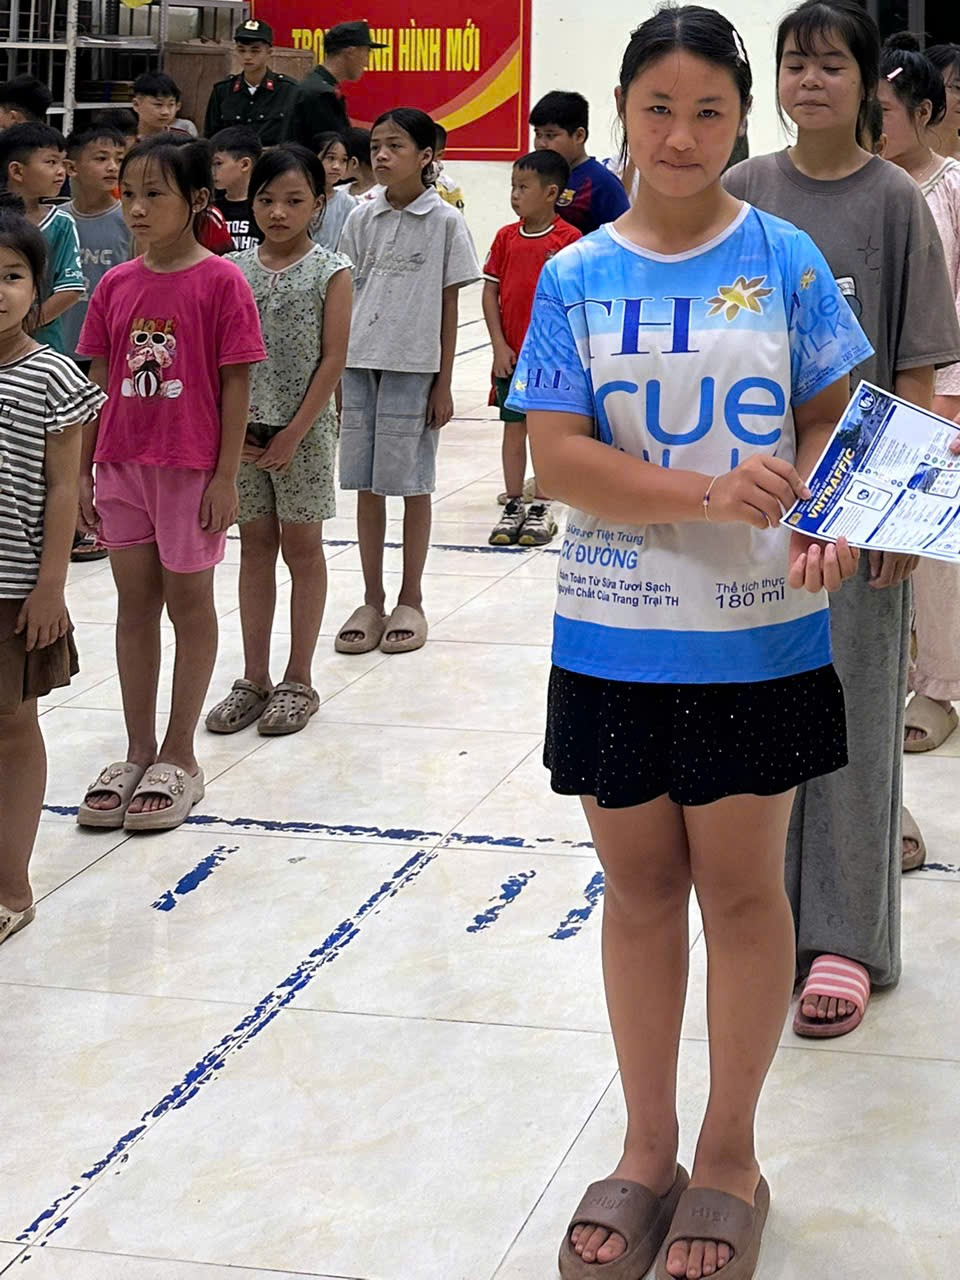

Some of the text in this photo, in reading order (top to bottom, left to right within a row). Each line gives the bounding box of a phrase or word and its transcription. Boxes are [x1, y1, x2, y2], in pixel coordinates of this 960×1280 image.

[291, 27, 327, 64] TRO
[398, 18, 441, 72] HÌNH
[446, 18, 481, 72] MỚI
[808, 447, 855, 518] VNTRAFFIC
[617, 531, 644, 546] Trùng
[575, 543, 638, 569] ĐƯỜNG
[619, 580, 642, 591] Tươi
[645, 581, 671, 594] Sạch
[741, 580, 759, 593] tích
[762, 577, 785, 588] thực
[611, 593, 639, 607] Trang
[642, 595, 662, 607] Trại
[665, 595, 679, 606] TH
[715, 585, 785, 609] 180 ml
